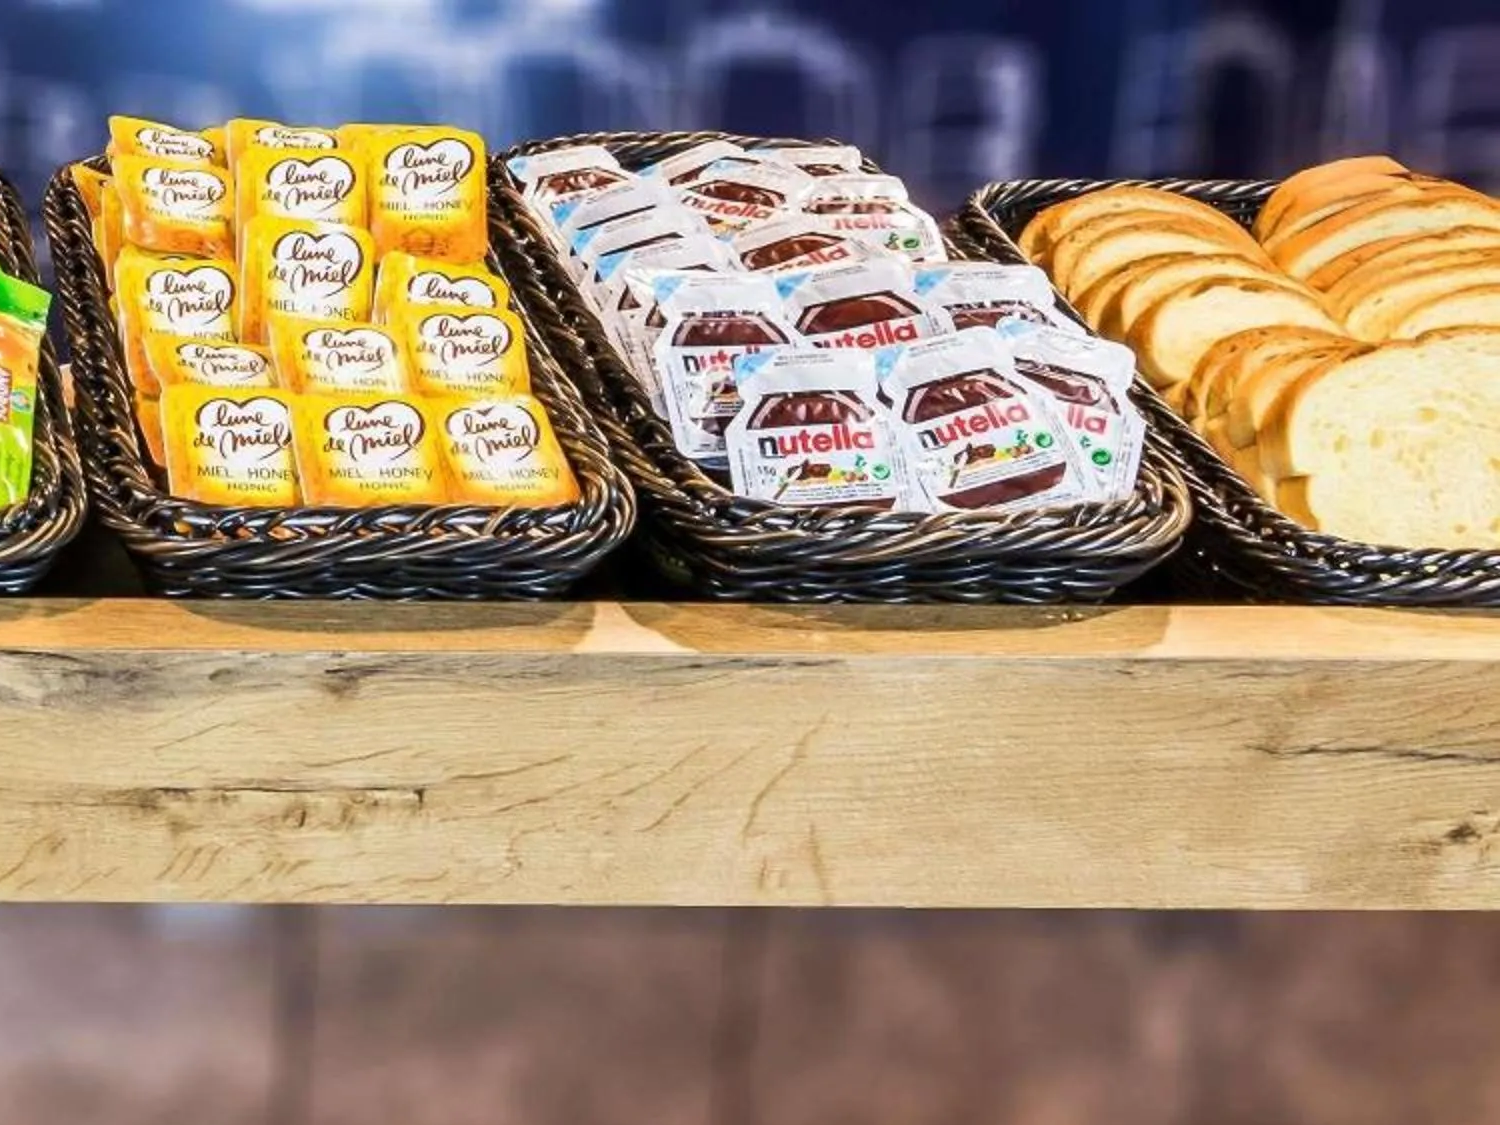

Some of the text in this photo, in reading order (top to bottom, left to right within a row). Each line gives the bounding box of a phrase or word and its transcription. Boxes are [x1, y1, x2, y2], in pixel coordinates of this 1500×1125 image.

[400, 148, 449, 168] lune
[282, 164, 332, 184] lune
[402, 161, 463, 195] miel
[285, 183, 345, 211] miel
[288, 238, 340, 262] lune
[290, 262, 352, 293] miel
[434, 318, 487, 338] lune
[442, 336, 502, 365] miel
[214, 404, 266, 427] lune
[341, 410, 398, 431] lune
[464, 414, 516, 435] lune
[917, 401, 1031, 450] nutella
[219, 426, 285, 460] miel
[350, 425, 413, 461] miel
[476, 427, 532, 463] miel
[758, 424, 874, 458] nutella
[197, 466, 234, 479] MIEL
